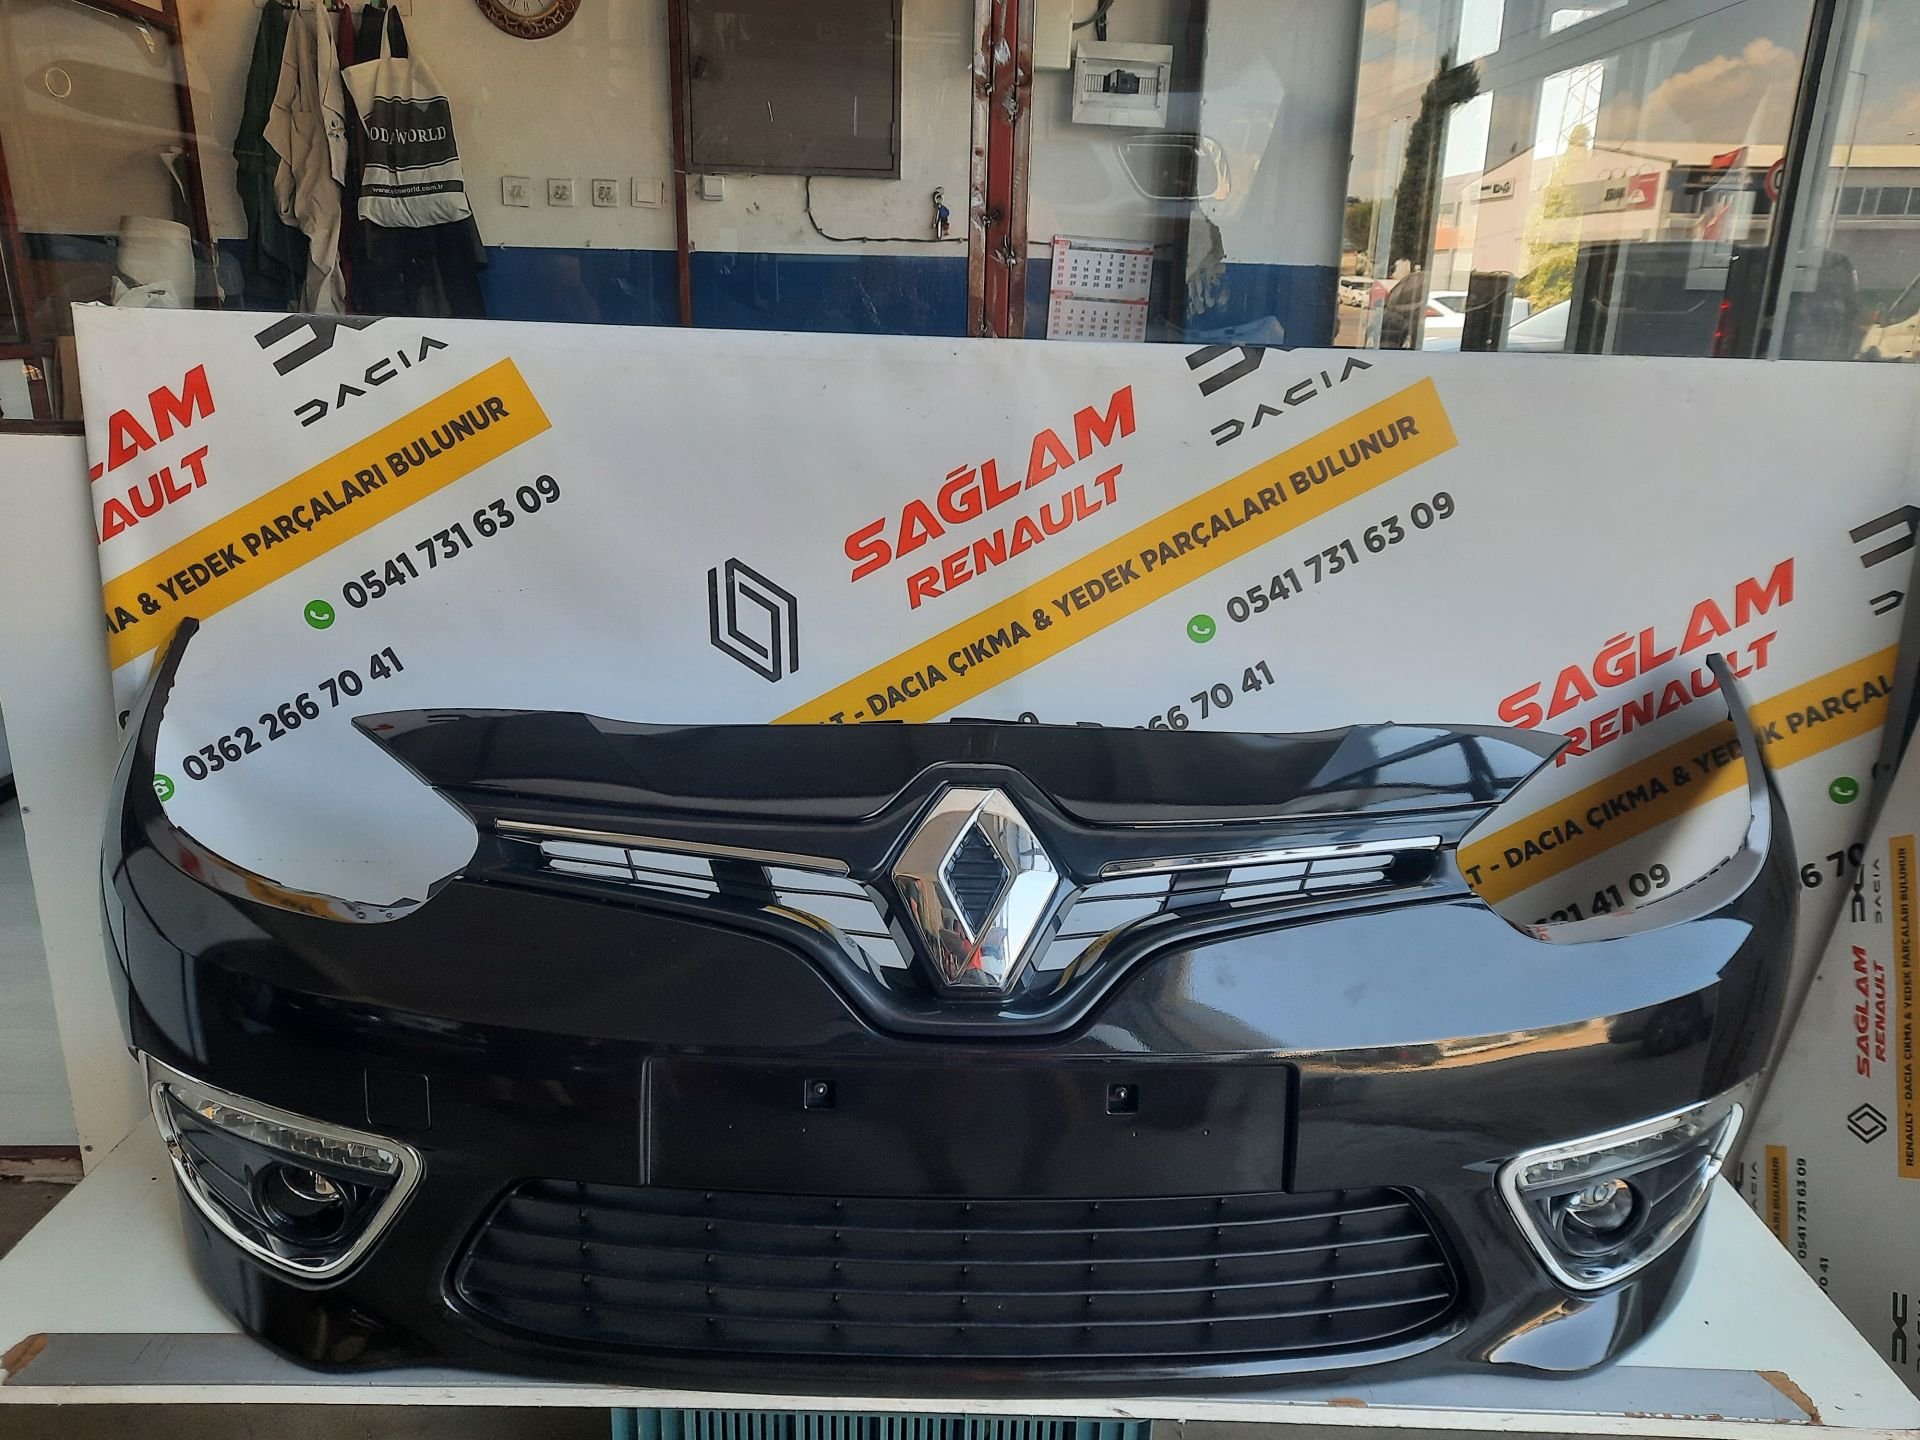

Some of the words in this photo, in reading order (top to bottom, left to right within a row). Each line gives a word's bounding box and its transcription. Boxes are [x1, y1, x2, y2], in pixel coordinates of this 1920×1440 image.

[395, 126, 447, 145] WORLD
[88, 364, 216, 482] AM
[294, 336, 448, 427] DACIA
[1210, 357, 1372, 447] DACIA
[97, 445, 209, 544] AULT
[137, 593, 162, 616] &
[157, 544, 245, 601] YEDEK
[242, 465, 387, 556] PARÇALARI
[385, 397, 509, 477] BULUNUR
[844, 385, 1136, 582] SAĞLAM
[343, 553, 419, 608] 0541
[415, 525, 474, 569] 731
[473, 500, 514, 537] 63
[517, 475, 560, 513] 09
[867, 664, 948, 717] DACIA
[947, 620, 1032, 678] ÇIKMA
[1033, 610, 1053, 632] &
[1051, 561, 1137, 618] YEDEK
[1141, 483, 1289, 573] PARÇALARI
[1289, 416, 1420, 496] BULUNUR
[906, 464, 1123, 609] RENAULT
[1226, 568, 1304, 624] 0541
[1302, 538, 1360, 585] 731
[1364, 514, 1406, 555] 63
[1411, 491, 1456, 530] 09
[1498, 557, 1794, 730] SAĞLAM
[183, 727, 262, 780] 0362
[259, 693, 319, 741] 266
[319, 670, 362, 707] 70
[371, 648, 404, 679] 41
[1134, 705, 1190, 731] 66
[1190, 683, 1234, 720] 70
[1241, 660, 1276, 694] 41
[1555, 631, 1778, 768] RENAULT
[1503, 819, 1583, 869] DACIA
[1586, 777, 1669, 831] ÇIKMA
[1672, 765, 1691, 787] &
[1693, 720, 1785, 775] YEDK
[1592, 884, 1625, 914] 41
[1628, 863, 1671, 897] 09
[1873, 959, 1887, 1063] RENAULT
[1902, 971, 1912, 1009] YEDEK
[1904, 1065, 1913, 1100] DACIA
[1797, 1157, 1807, 1176] 09
[1904, 1111, 1914, 1167] RENAULT
[1797, 1180, 1807, 1197] 63
[1797, 1200, 1807, 1223] 731
[1797, 1226, 1807, 1260] 0541
[1819, 1257, 1829, 1274] 41
